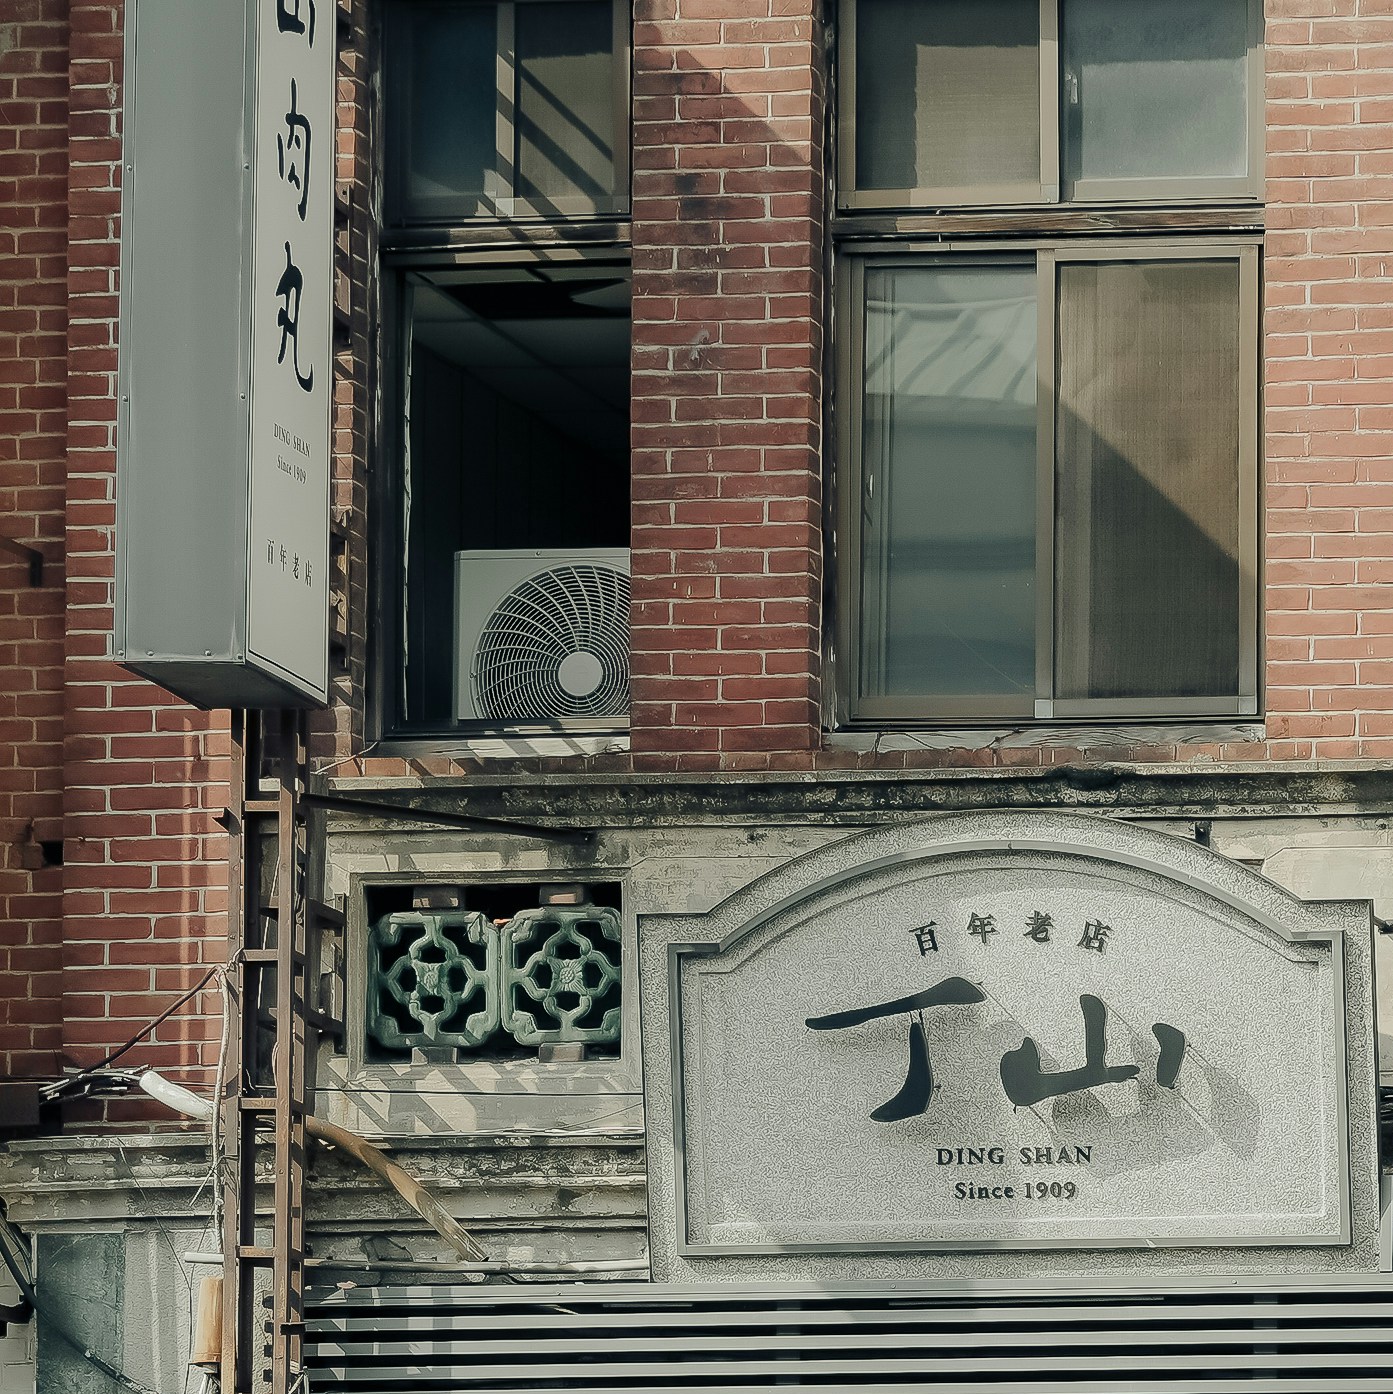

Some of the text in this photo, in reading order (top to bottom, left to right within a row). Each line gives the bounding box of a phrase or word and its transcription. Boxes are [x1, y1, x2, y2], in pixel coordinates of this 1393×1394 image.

[273, 423, 310, 457] DING SHAN
[277, 455, 307, 484] Since 1909
[267, 539, 312, 587] 百年老店
[909, 910, 1114, 957] 百年老店
[805, 976, 1188, 1123] 丁山
[935, 1146, 1093, 1166] DING SHAN
[954, 1181, 1076, 1200] Since 1909
